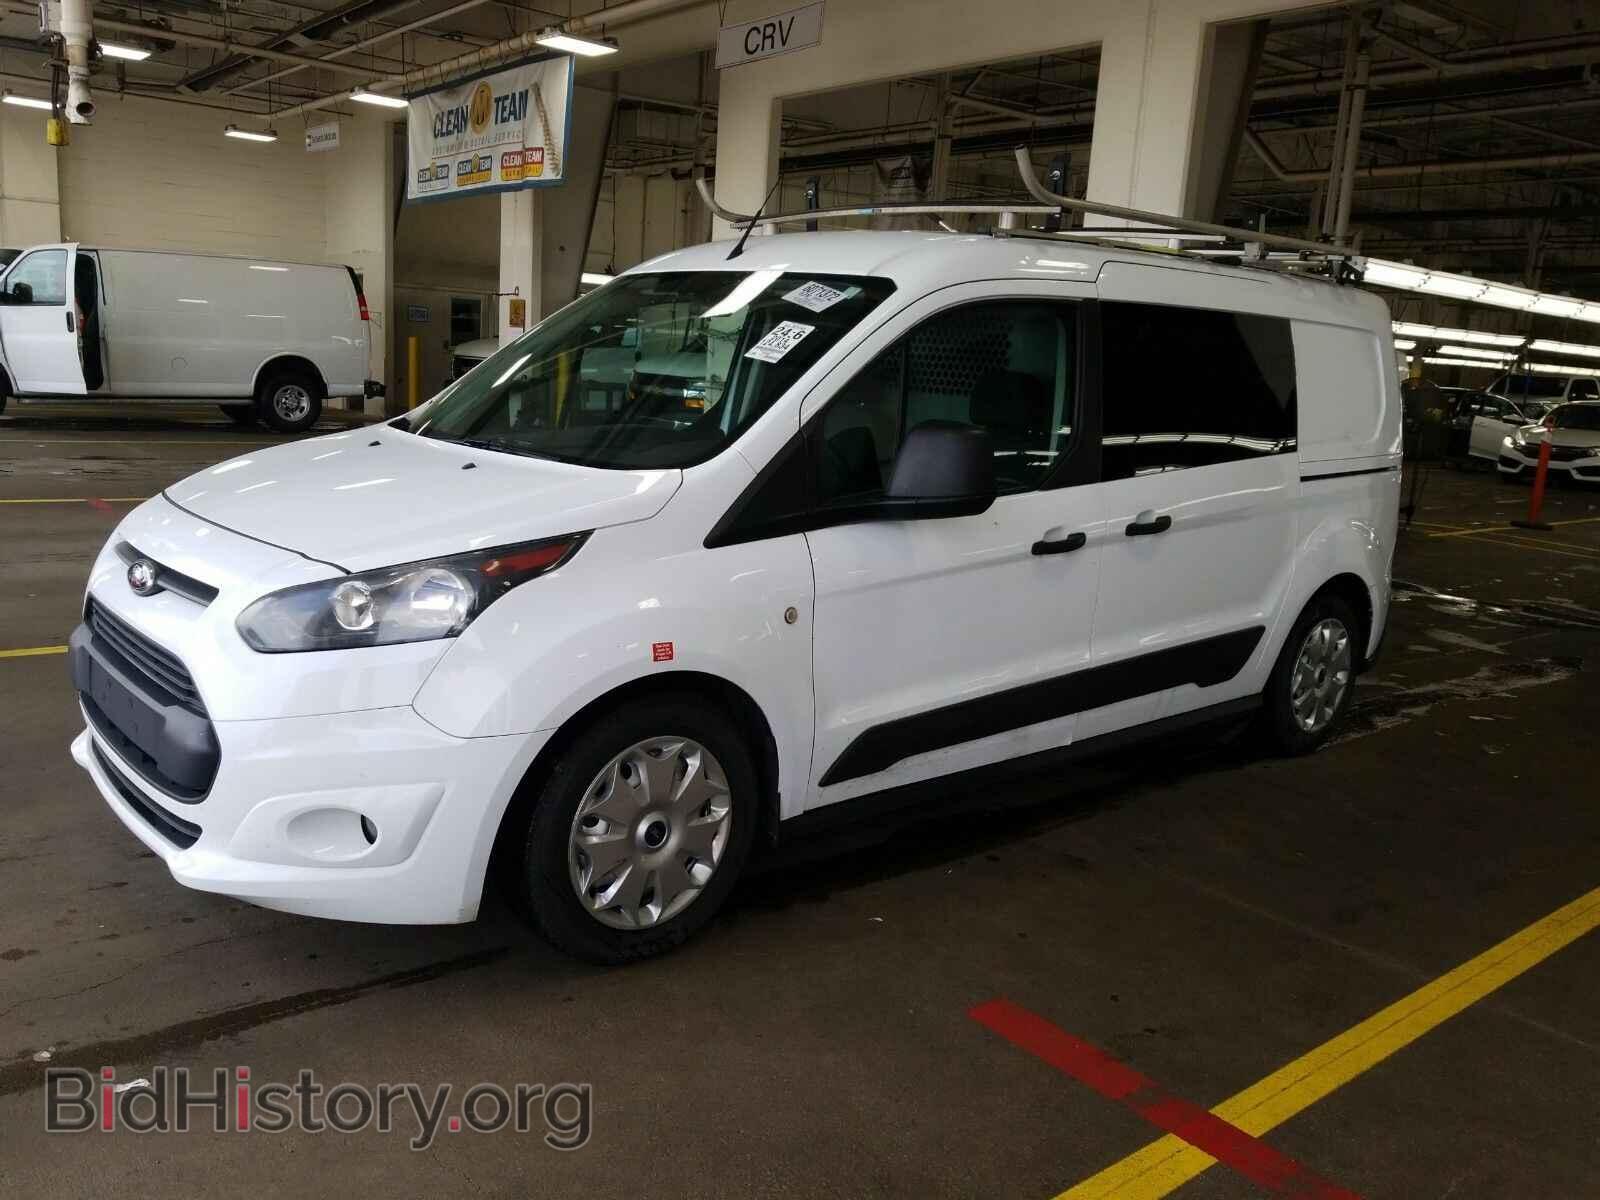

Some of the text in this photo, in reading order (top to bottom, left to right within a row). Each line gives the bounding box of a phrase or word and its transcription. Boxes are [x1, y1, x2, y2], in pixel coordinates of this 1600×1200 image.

[744, 16, 795, 55] CRV
[433, 89, 529, 139] CLEAN TEAM
[503, 150, 543, 167] CLEAN TEAM
